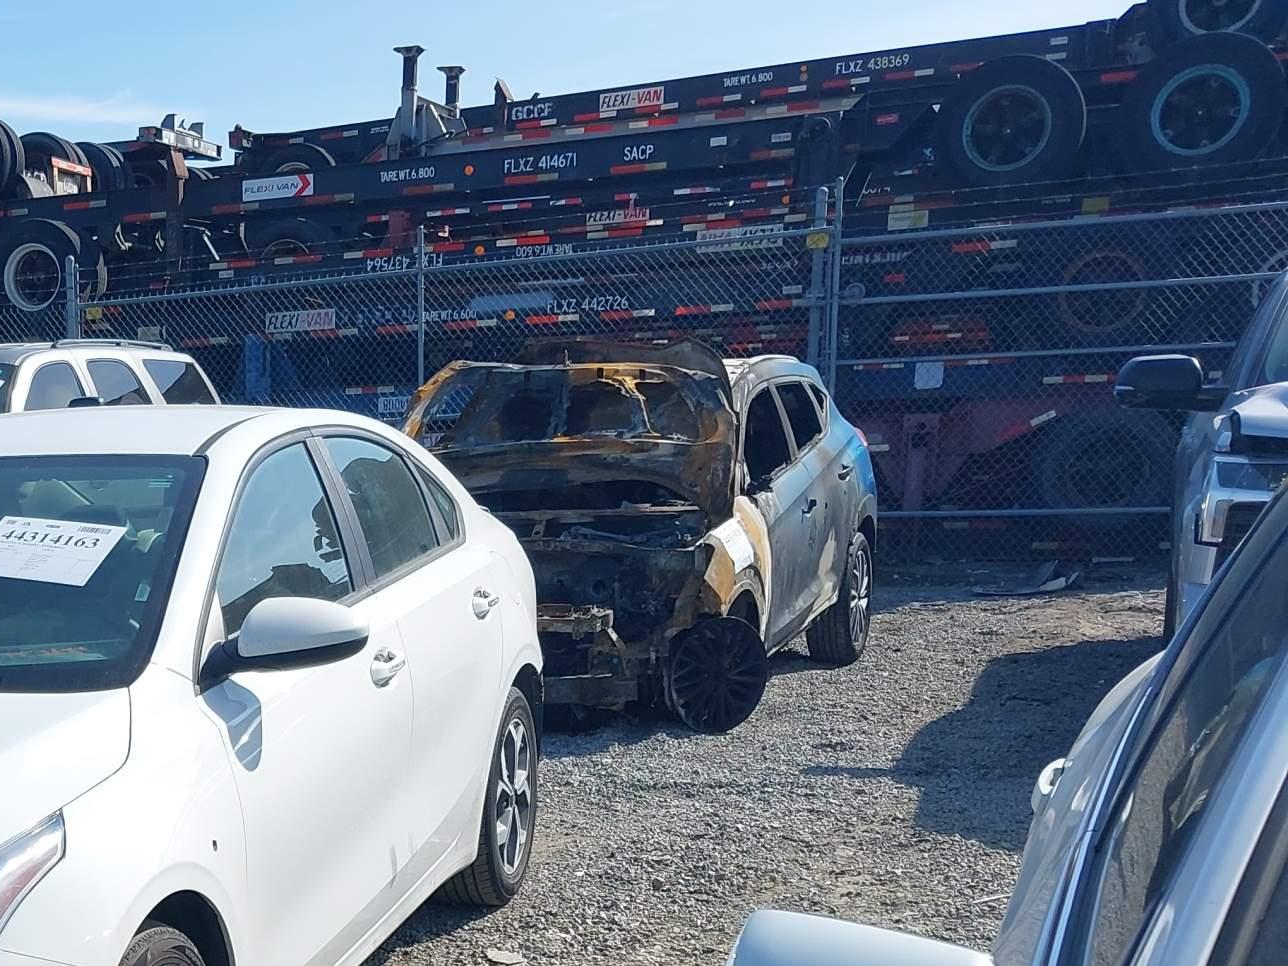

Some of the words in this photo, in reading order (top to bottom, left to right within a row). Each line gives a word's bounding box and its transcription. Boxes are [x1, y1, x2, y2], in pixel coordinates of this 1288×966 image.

[835, 59, 863, 75] FLXZ
[867, 53, 910, 70] 438369
[600, 89, 663, 109] FLEXI-VAN
[624, 144, 654, 161] SACP
[504, 157, 534, 174] FLXZ
[538, 152, 578, 170] 414671
[244, 184, 274, 194] FLEXI
[276, 182, 299, 191] VAN
[366, 255, 410, 272] 437564
[547, 299, 577, 314] FLXZ
[581, 296, 629, 311] 442726
[267, 311, 335, 331] FLEXI-VAN
[1, 530, 101, 549] 44314163
